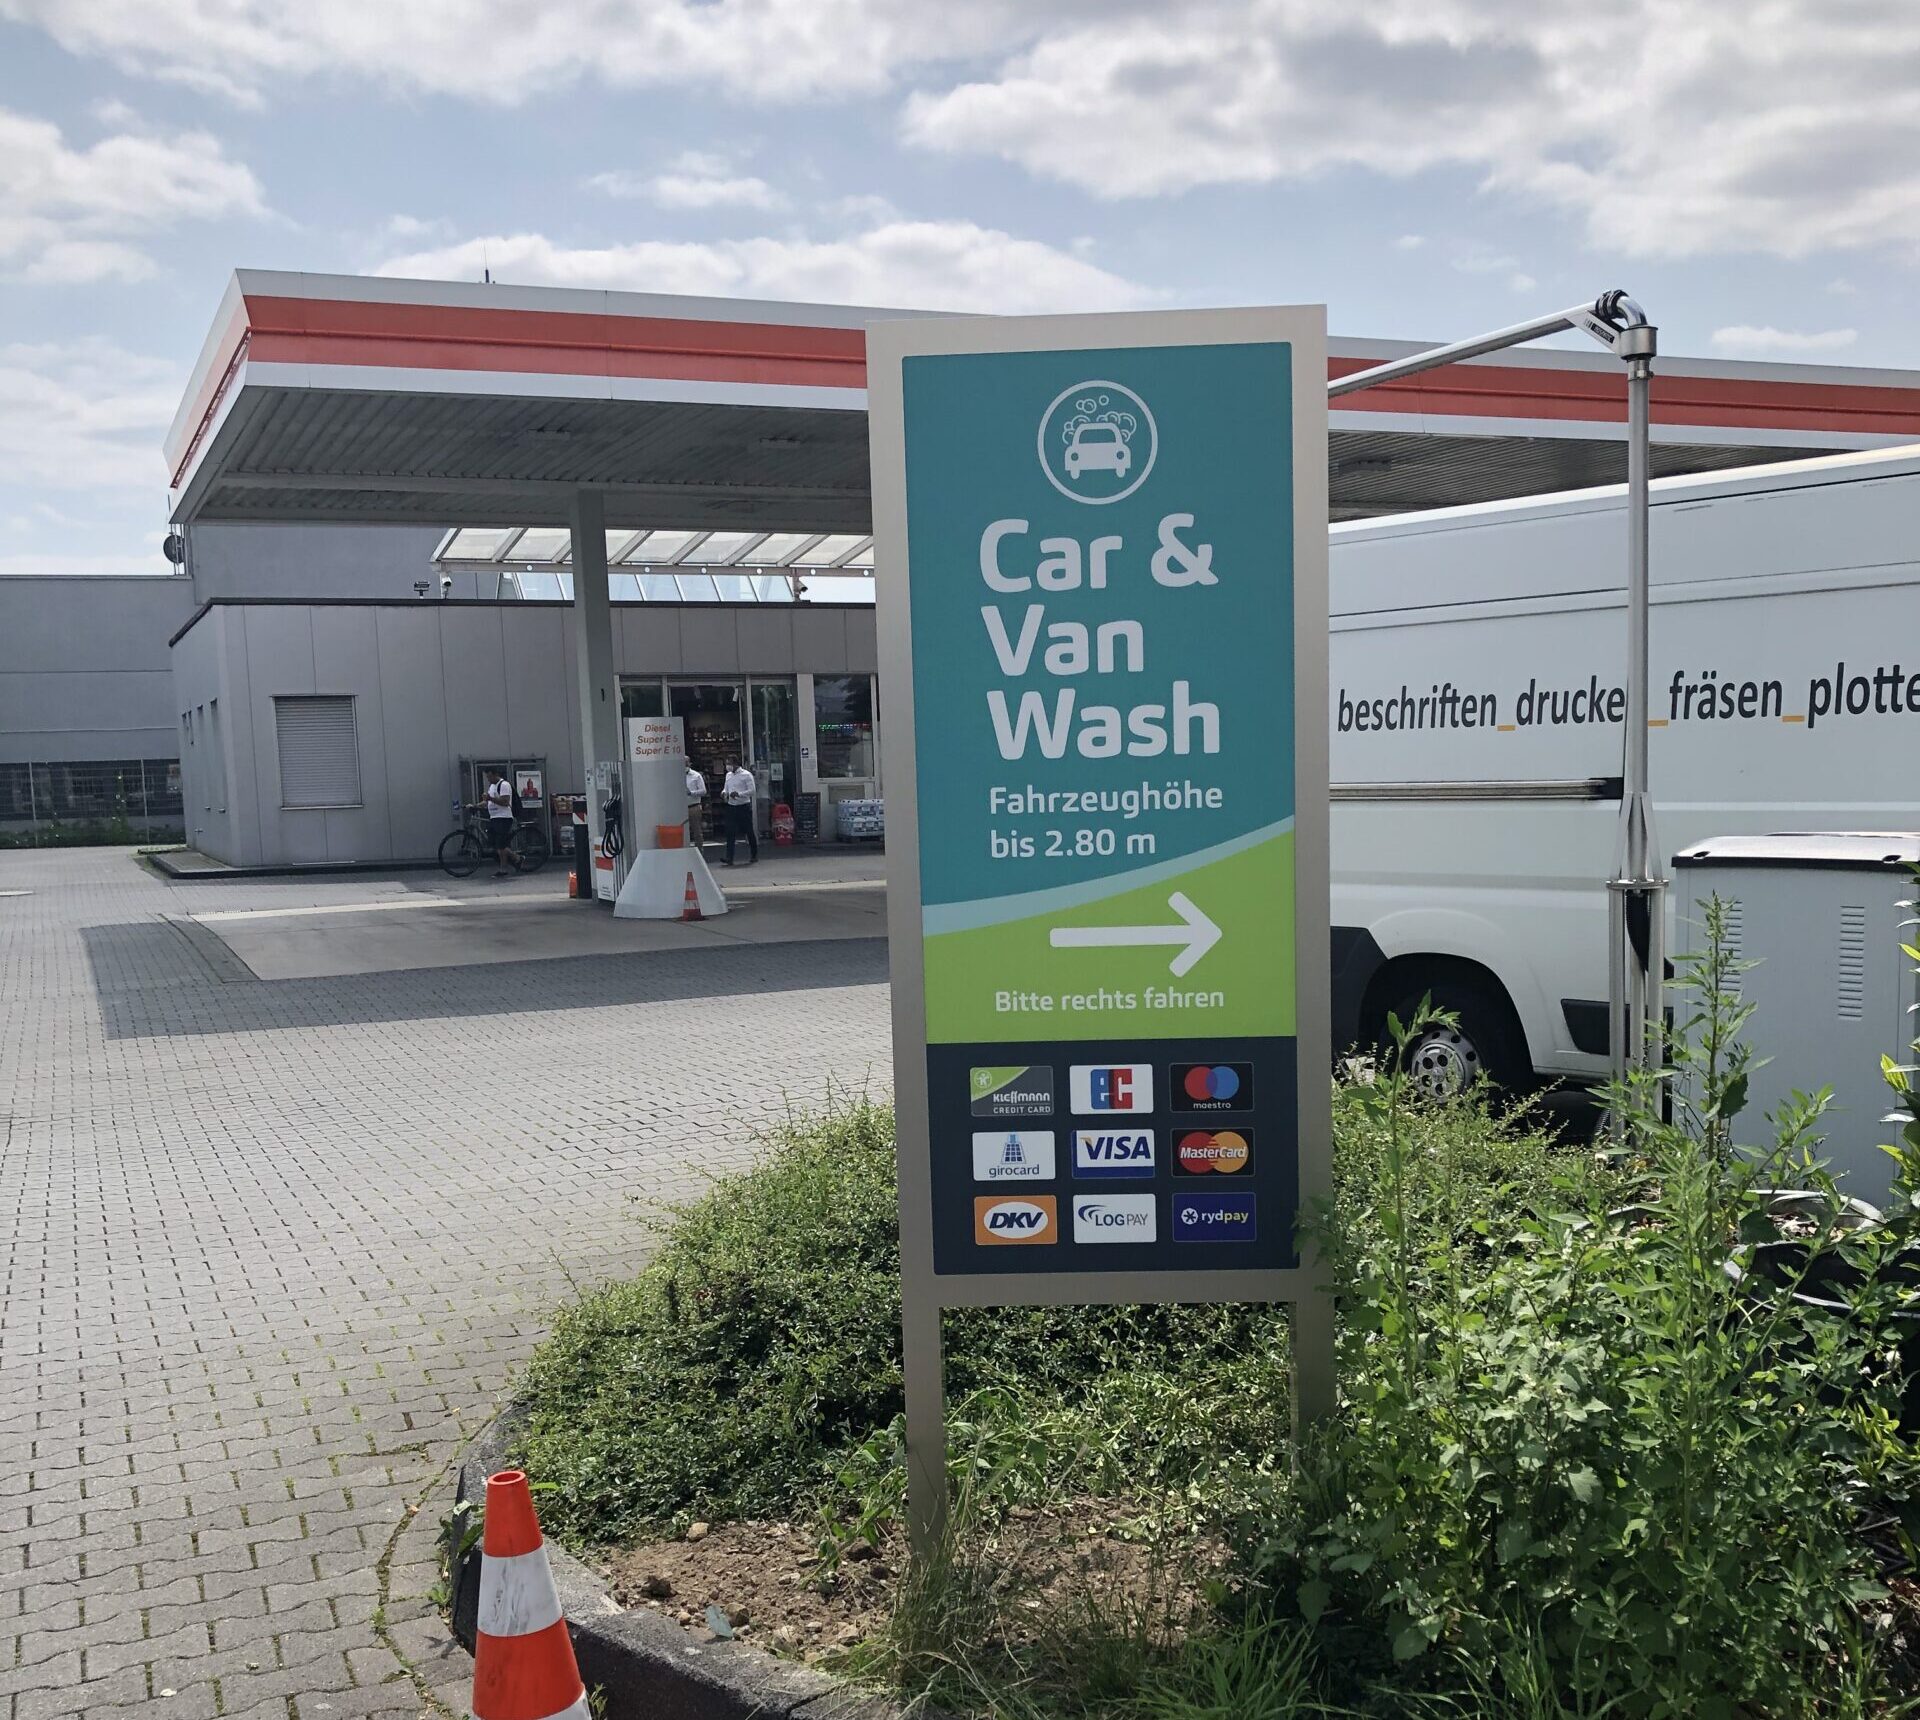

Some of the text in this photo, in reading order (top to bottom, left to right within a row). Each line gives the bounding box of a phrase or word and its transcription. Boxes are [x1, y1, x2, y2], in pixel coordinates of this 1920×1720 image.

[980, 513, 1219, 593] Car &
[980, 604, 1144, 677] Van
[644, 724, 671, 733] Diesel
[986, 681, 1220, 760] Wash
[637, 735, 663, 745] Super
[635, 746, 661, 756] Super
[672, 746, 681, 754] 10
[990, 780, 1223, 819] Fahrzeughöhe
[990, 829, 1156, 859] bis 2.80 m
[995, 986, 1224, 1012] Bitte rechts fahren
[993, 1105, 1051, 1114] CREDIT CARD
[1193, 1101, 1232, 1109] maestro
[1081, 1136, 1151, 1160] VISA
[1180, 1146, 1247, 1159] MasterCard
[989, 1163, 1040, 1178] girocard
[989, 1212, 1044, 1229] DKV
[1201, 1210, 1249, 1225] rydpay
